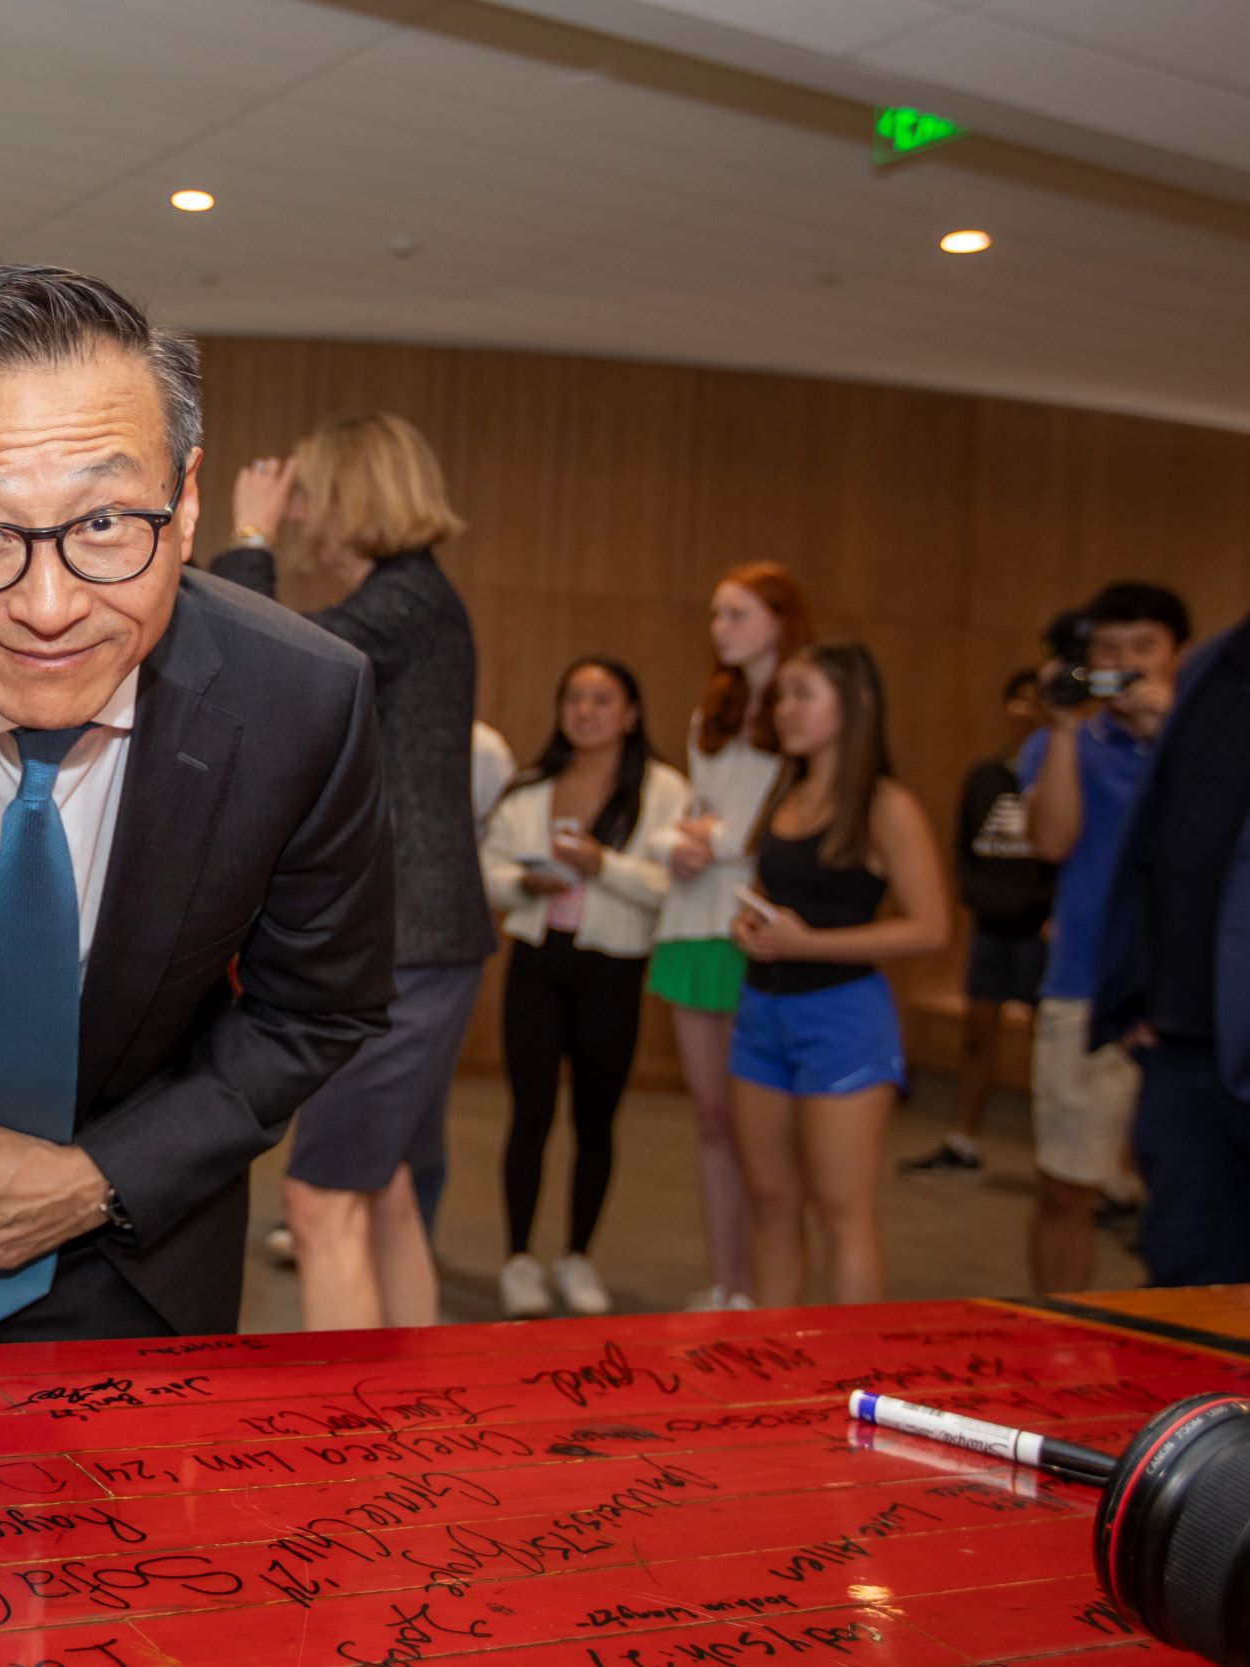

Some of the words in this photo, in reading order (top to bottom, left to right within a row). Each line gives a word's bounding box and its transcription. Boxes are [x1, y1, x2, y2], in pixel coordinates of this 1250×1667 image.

[188, 1450, 296, 1473] Lim
[303, 1431, 534, 1467] Chelsea
[1144, 1440, 1175, 1474] CANON
[768, 1535, 873, 1584] Allen
[12, 1556, 243, 1610] Sofia
